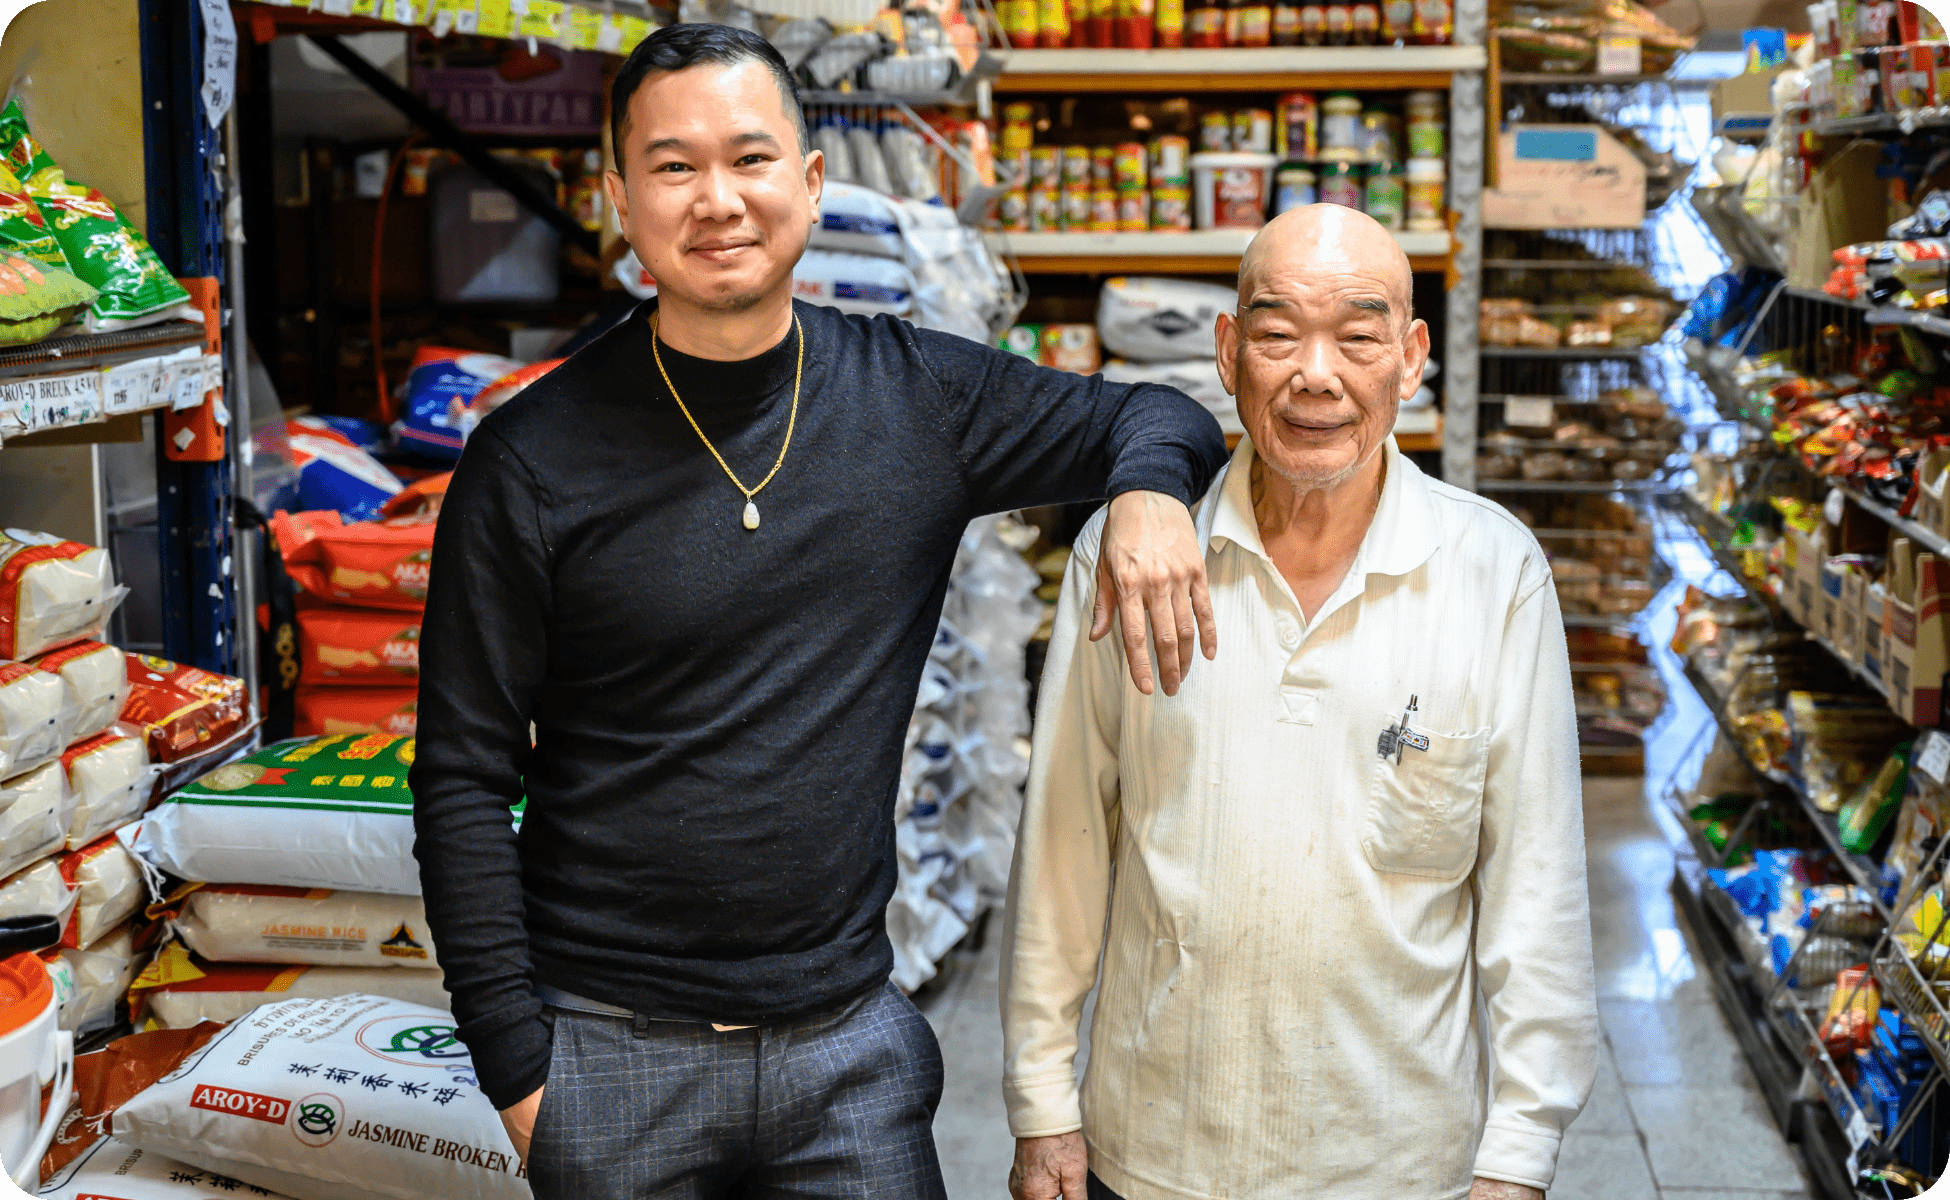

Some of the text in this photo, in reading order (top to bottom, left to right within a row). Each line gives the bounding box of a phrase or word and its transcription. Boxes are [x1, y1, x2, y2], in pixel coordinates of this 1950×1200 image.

[40, 379, 72, 399] BREUK
[261, 923, 367, 940] JASMINE RICE
[237, 1027, 287, 1066] BRISURES
[195, 1087, 286, 1119] AROY-D
[348, 1119, 430, 1154] JASMINE
[431, 1138, 513, 1174] BROKEN
[115, 1148, 143, 1175] BRISUR
